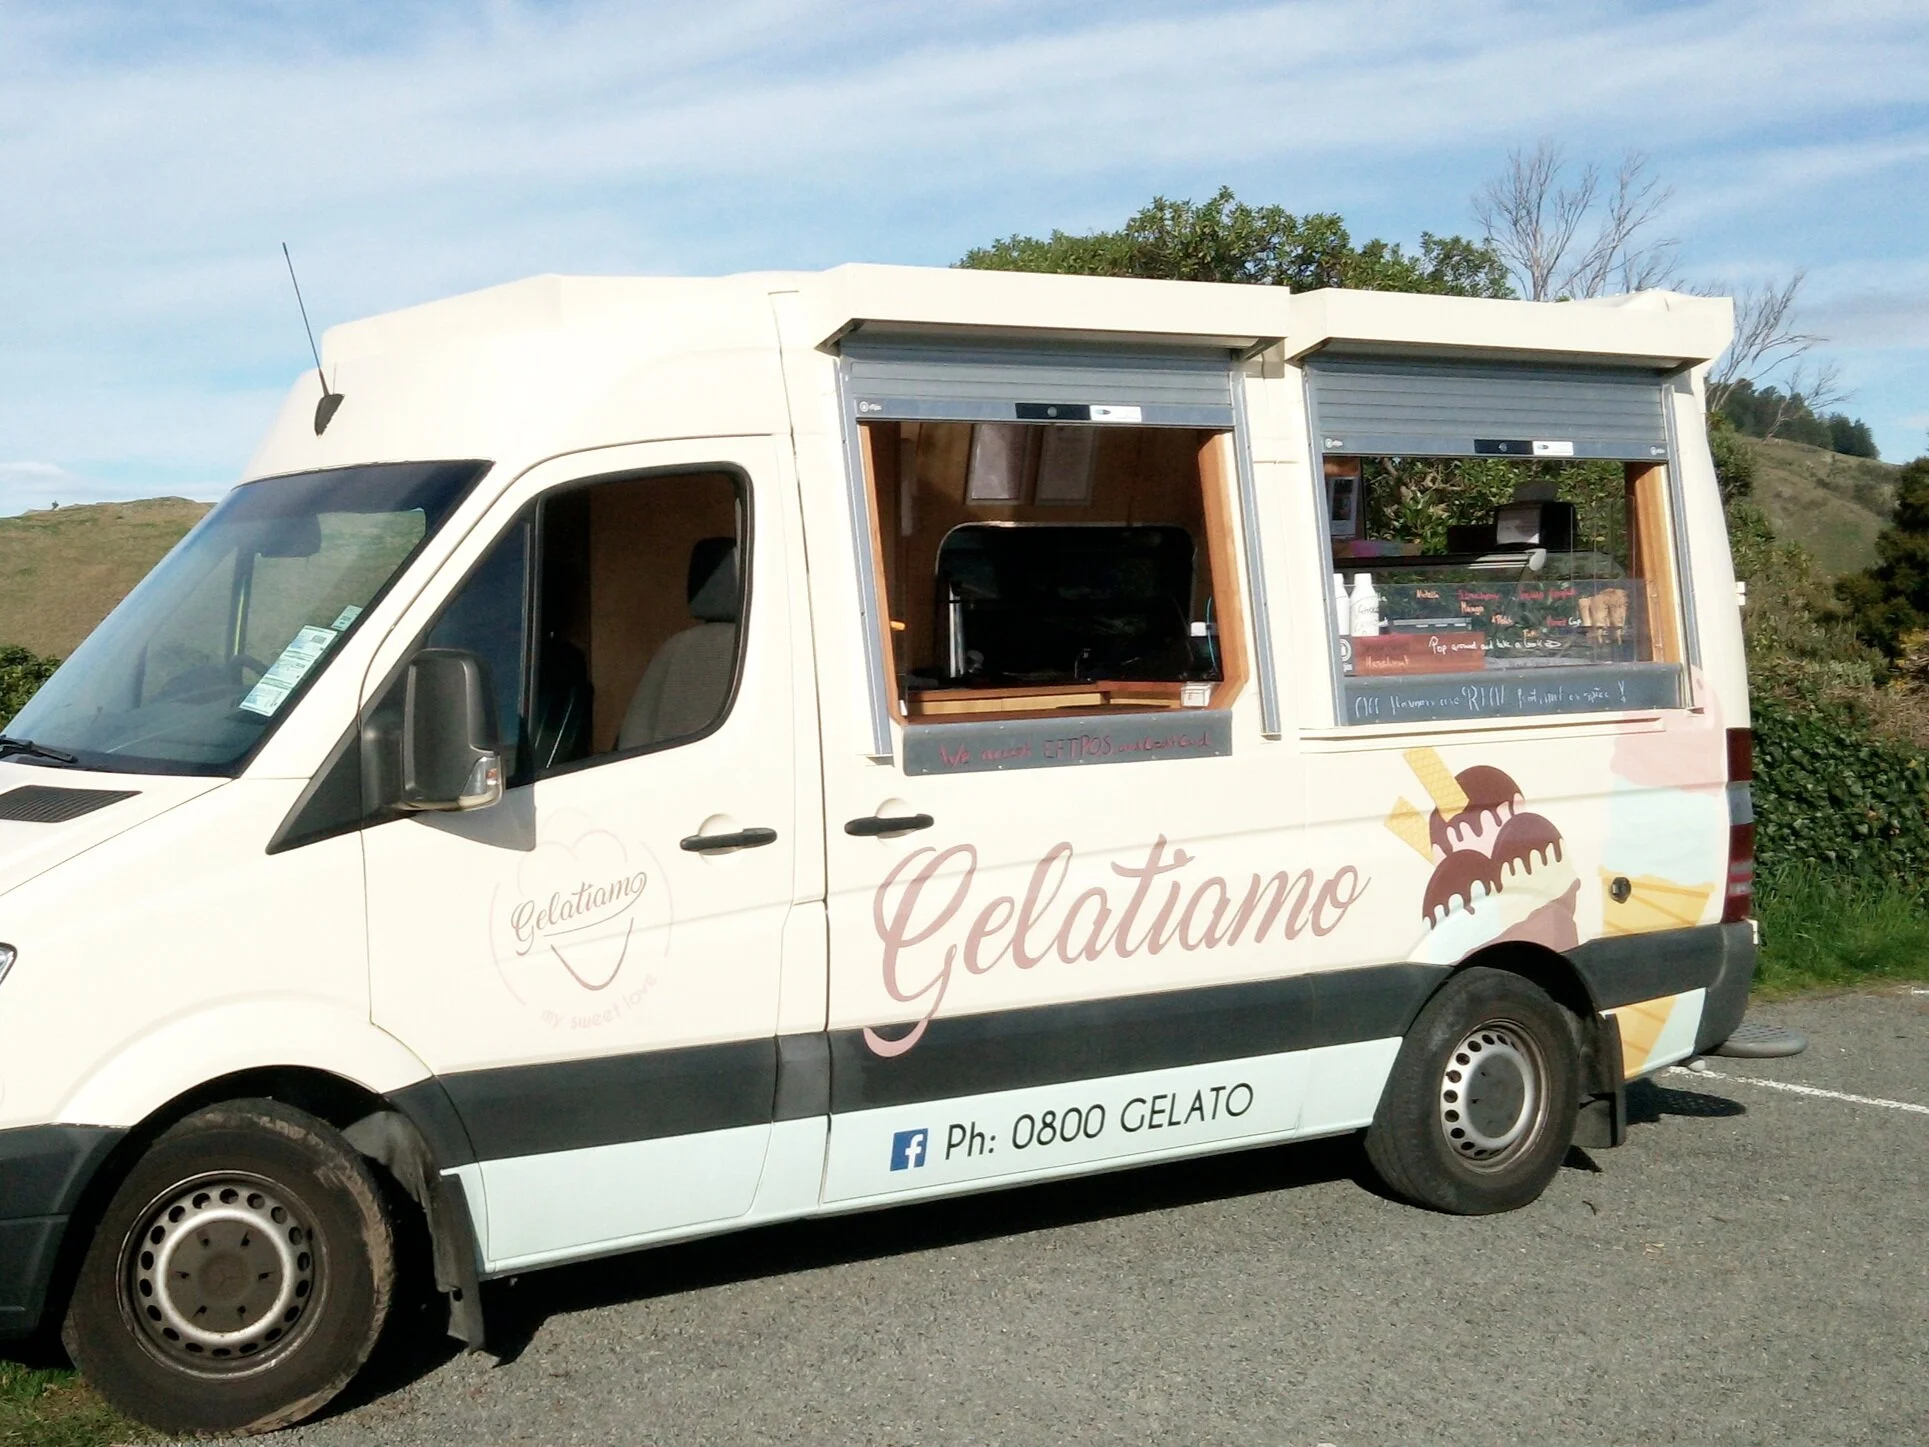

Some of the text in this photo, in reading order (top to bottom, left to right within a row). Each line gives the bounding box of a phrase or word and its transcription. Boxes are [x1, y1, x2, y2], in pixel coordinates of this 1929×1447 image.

[1429, 635, 1448, 656] Pop
[1451, 640, 1478, 652] around
[1480, 639, 1495, 651] and
[938, 743, 970, 769] We
[1043, 734, 1114, 760] EFTPOS
[510, 871, 648, 957] Gelatiamo
[863, 833, 1371, 1058] Gelatiamo
[540, 972, 657, 1030] my sweet love
[944, 1081, 1255, 1161] Ph: 0800 GELATO
